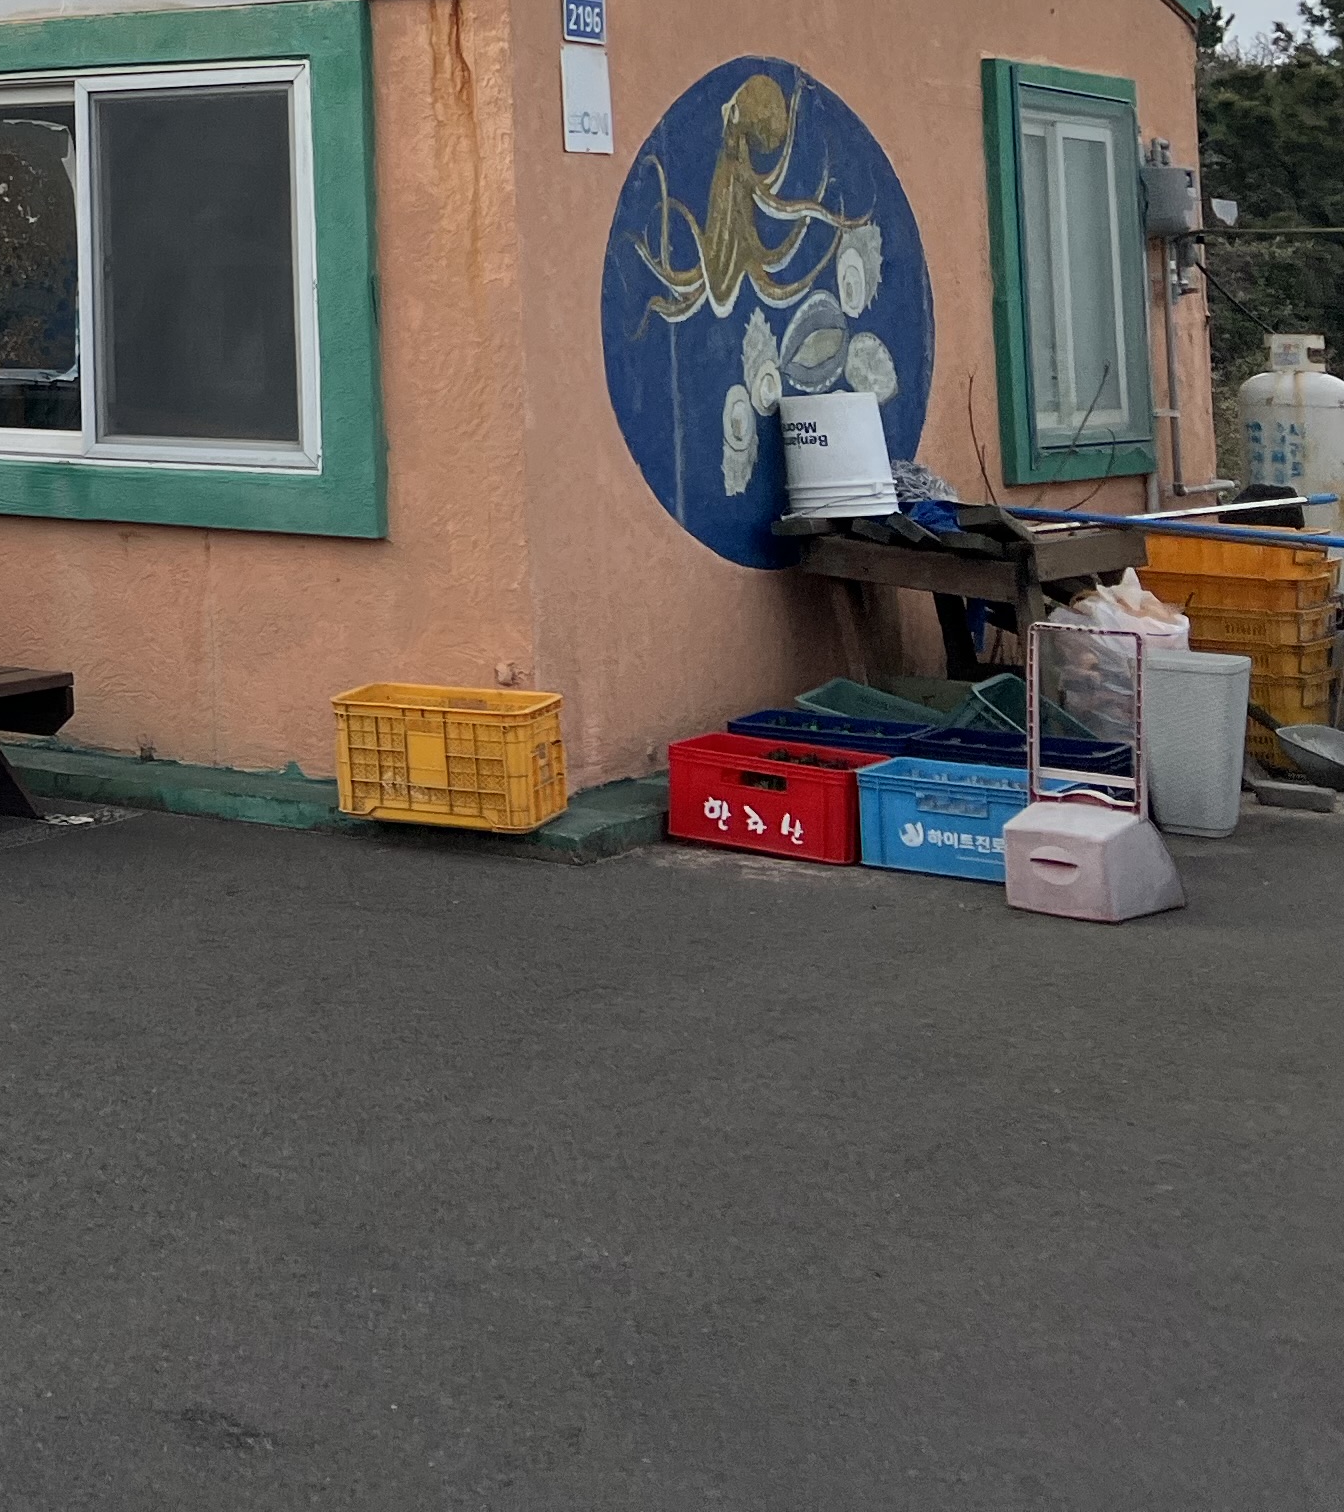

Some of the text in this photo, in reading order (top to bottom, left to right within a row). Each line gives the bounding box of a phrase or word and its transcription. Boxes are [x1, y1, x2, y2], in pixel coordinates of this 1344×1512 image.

[569, 3, 602, 33] 2196
[703, 796, 804, 846] 한라산
[927, 829, 1005, 854] 하이트진로
